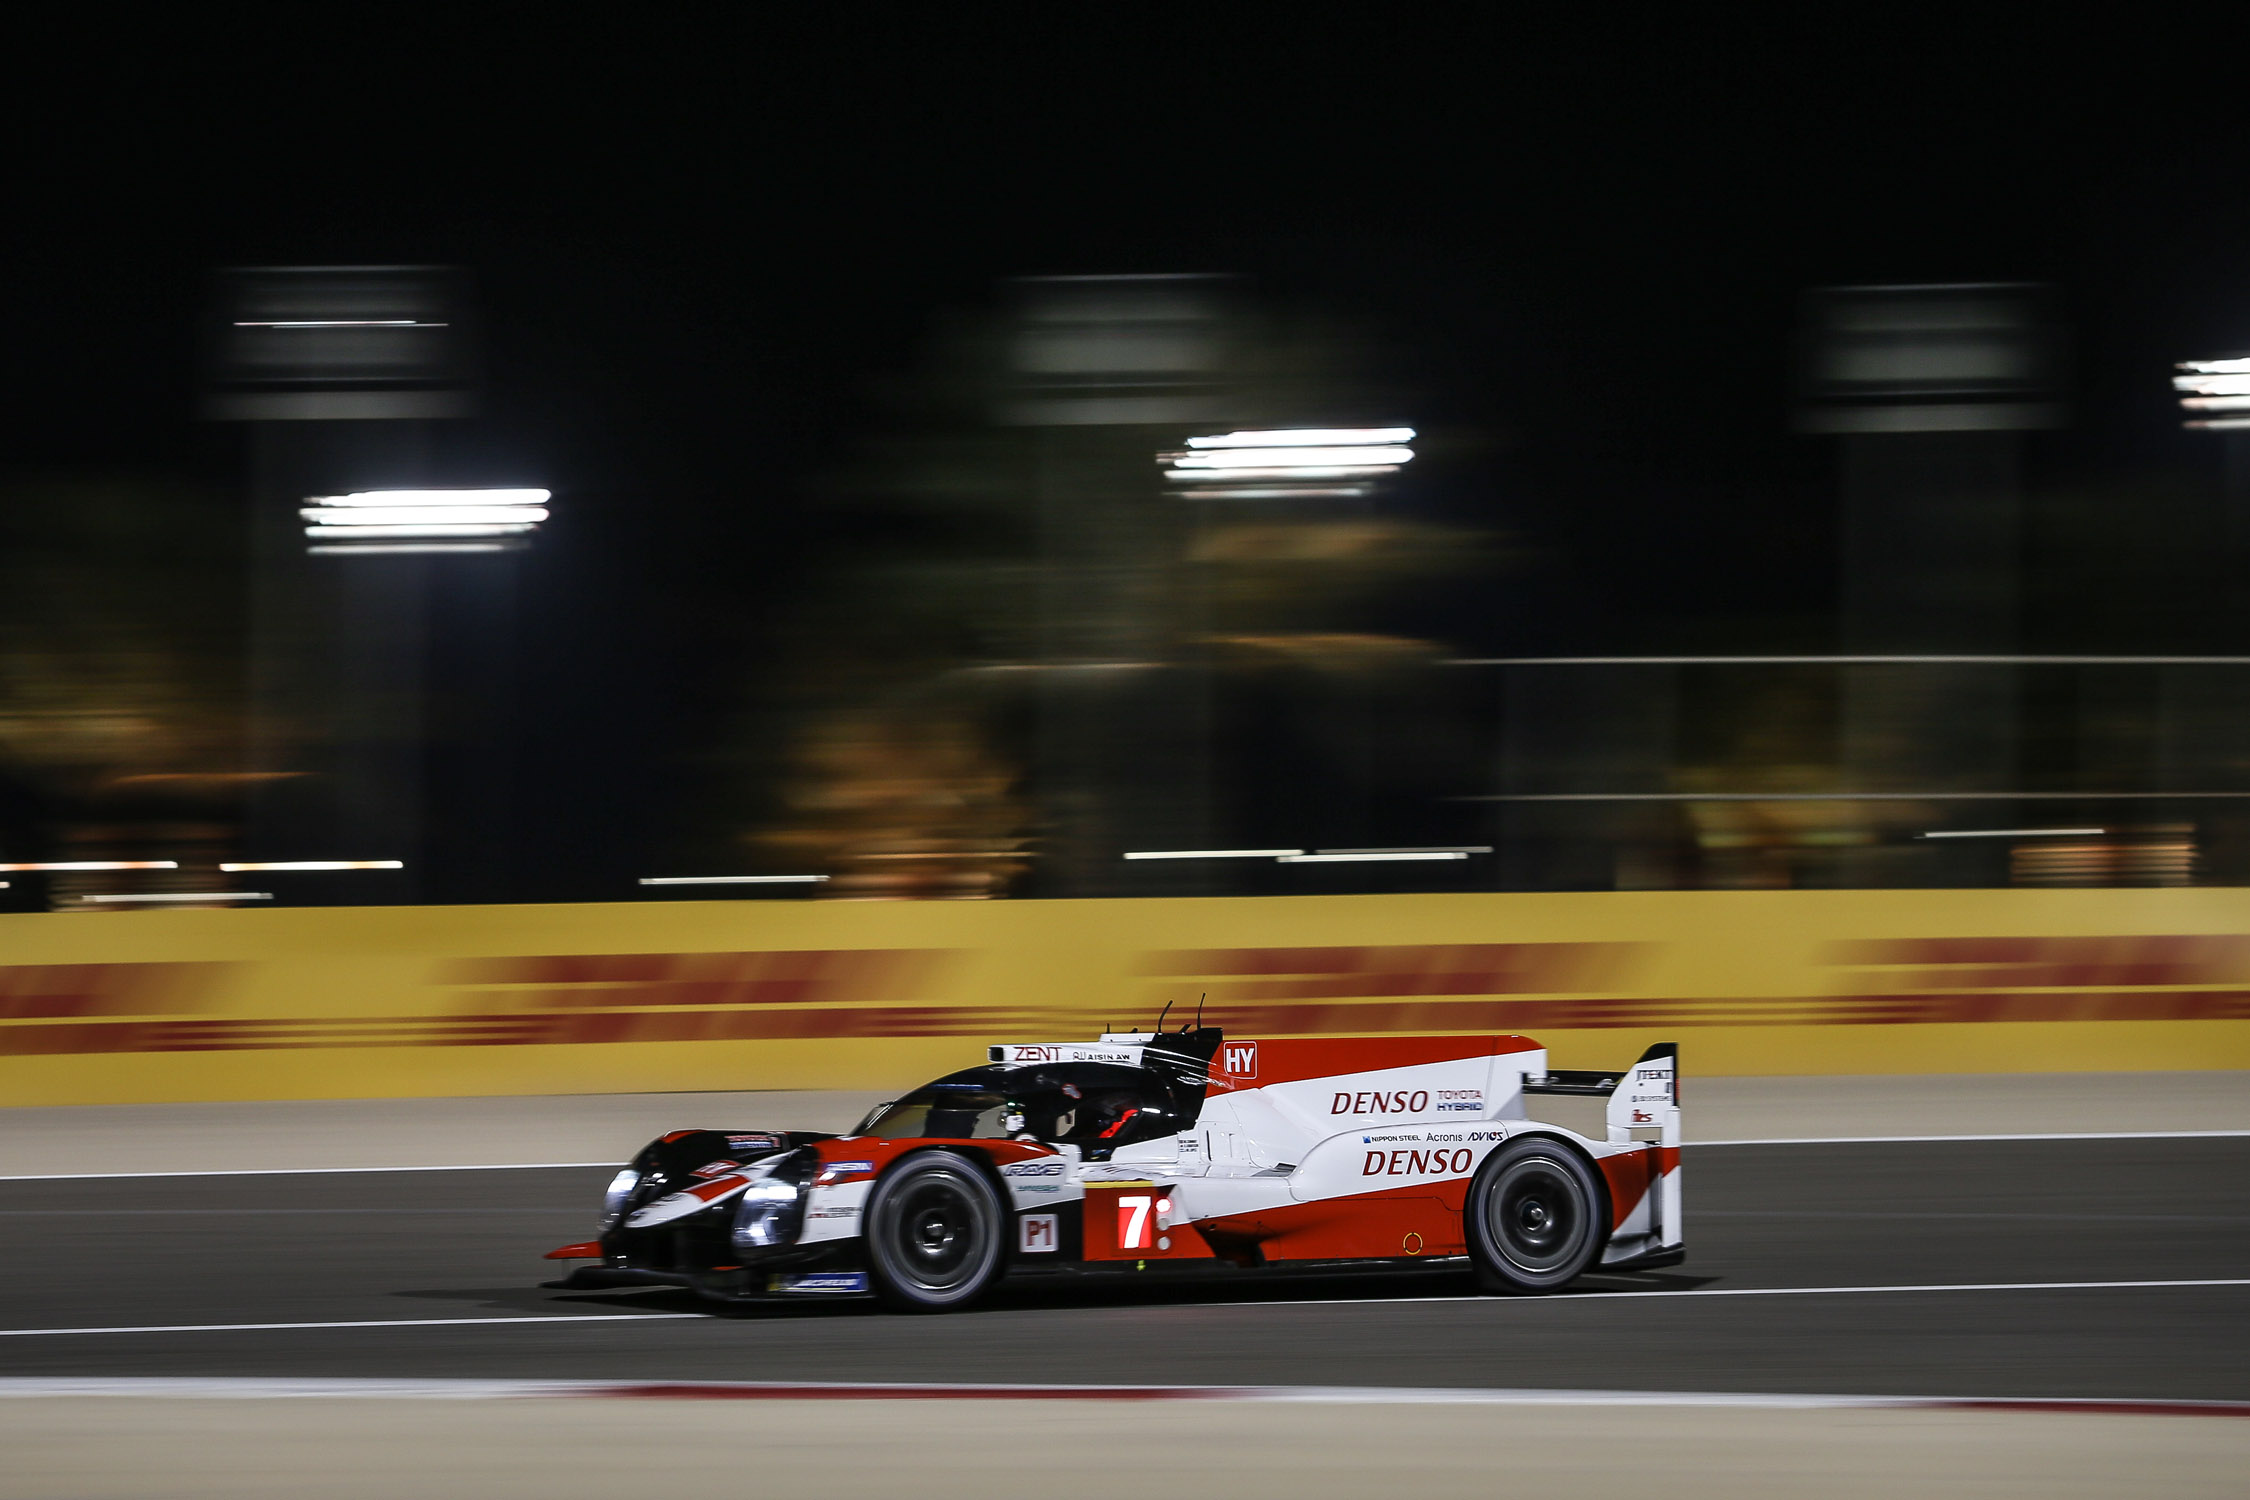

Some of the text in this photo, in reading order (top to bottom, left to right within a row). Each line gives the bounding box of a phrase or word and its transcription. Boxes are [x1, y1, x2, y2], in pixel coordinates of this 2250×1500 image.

[1013, 1046, 1062, 1061] ZENT
[1088, 1053, 1114, 1061] AISIN
[1116, 1053, 1131, 1061] AW
[1226, 1047, 1255, 1073] HY
[1436, 1090, 1483, 1100] TOYOTA
[1331, 1090, 1428, 1115] DENSO
[1436, 1102, 1484, 1111] HYBRID
[1371, 1134, 1421, 1143] NIPPON STEEL
[1426, 1132, 1463, 1142] Acronis
[1467, 1131, 1504, 1142] ADVICS
[1362, 1148, 1473, 1176] DENSO
[1118, 1196, 1151, 1249] 7
[1026, 1219, 1052, 1246] P1
